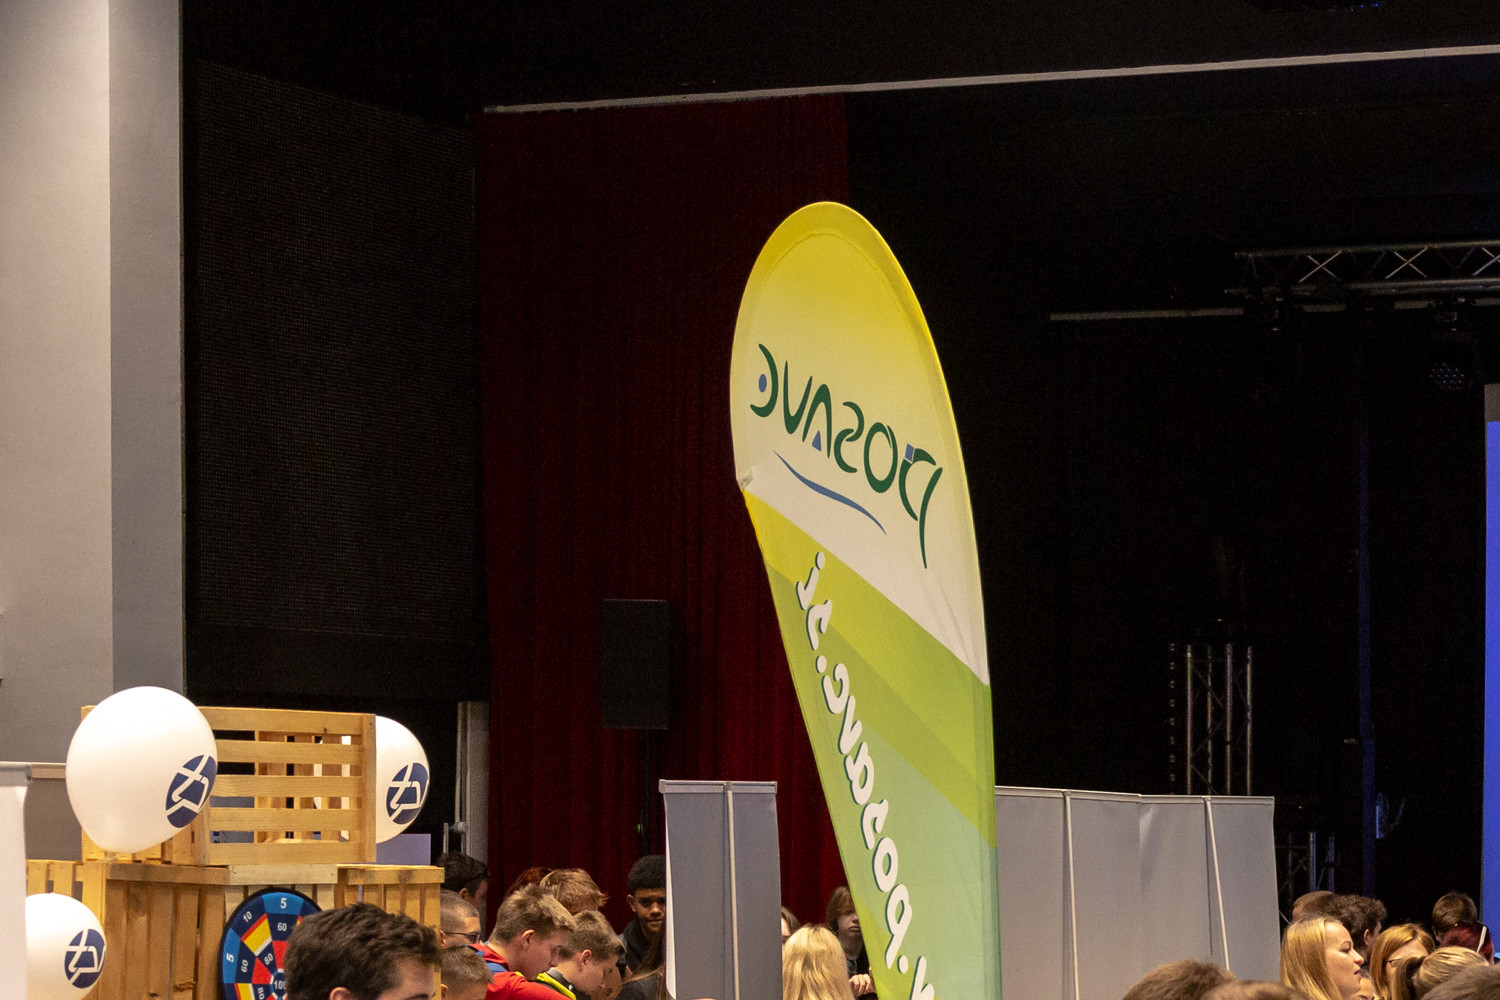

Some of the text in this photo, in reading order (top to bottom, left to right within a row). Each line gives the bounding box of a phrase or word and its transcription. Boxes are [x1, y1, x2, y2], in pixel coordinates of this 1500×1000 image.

[279, 897, 288, 909] 5
[243, 911, 253, 923] 10
[277, 922, 287, 932] 60
[264, 953, 274, 966] 80
